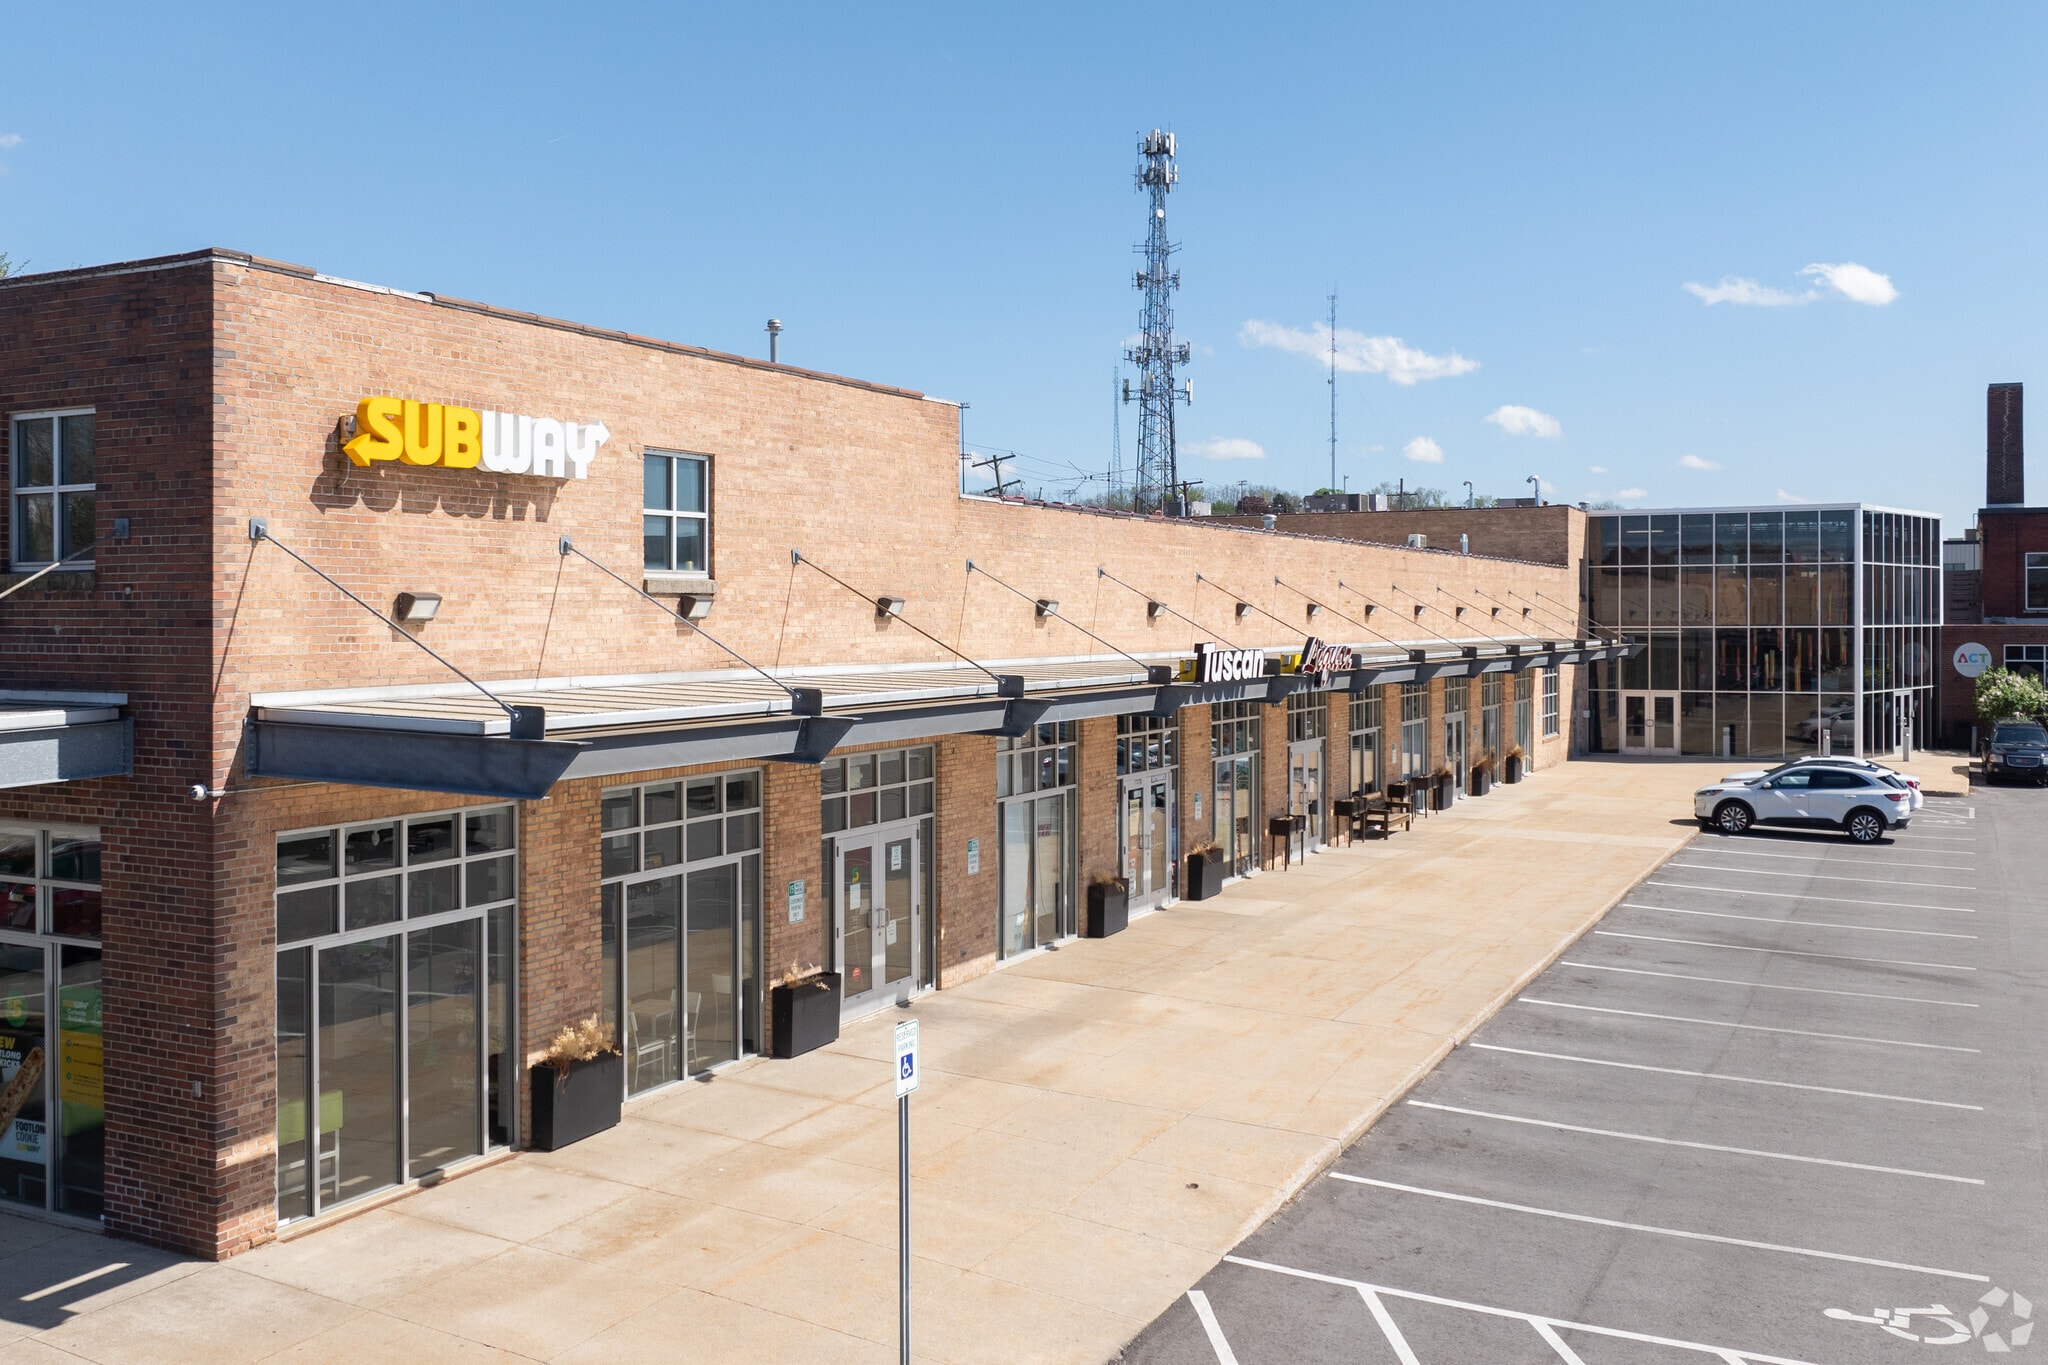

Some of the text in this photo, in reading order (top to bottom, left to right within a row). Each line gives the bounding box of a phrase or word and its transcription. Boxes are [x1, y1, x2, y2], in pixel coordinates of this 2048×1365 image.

[343, 396, 611, 479] SUBWAY
[1198, 643, 1265, 683] Tuscan
[1957, 653, 1988, 663] ACT
[16, 1120, 46, 1135] FOOTLON
[16, 1131, 39, 1145] COOKIE
